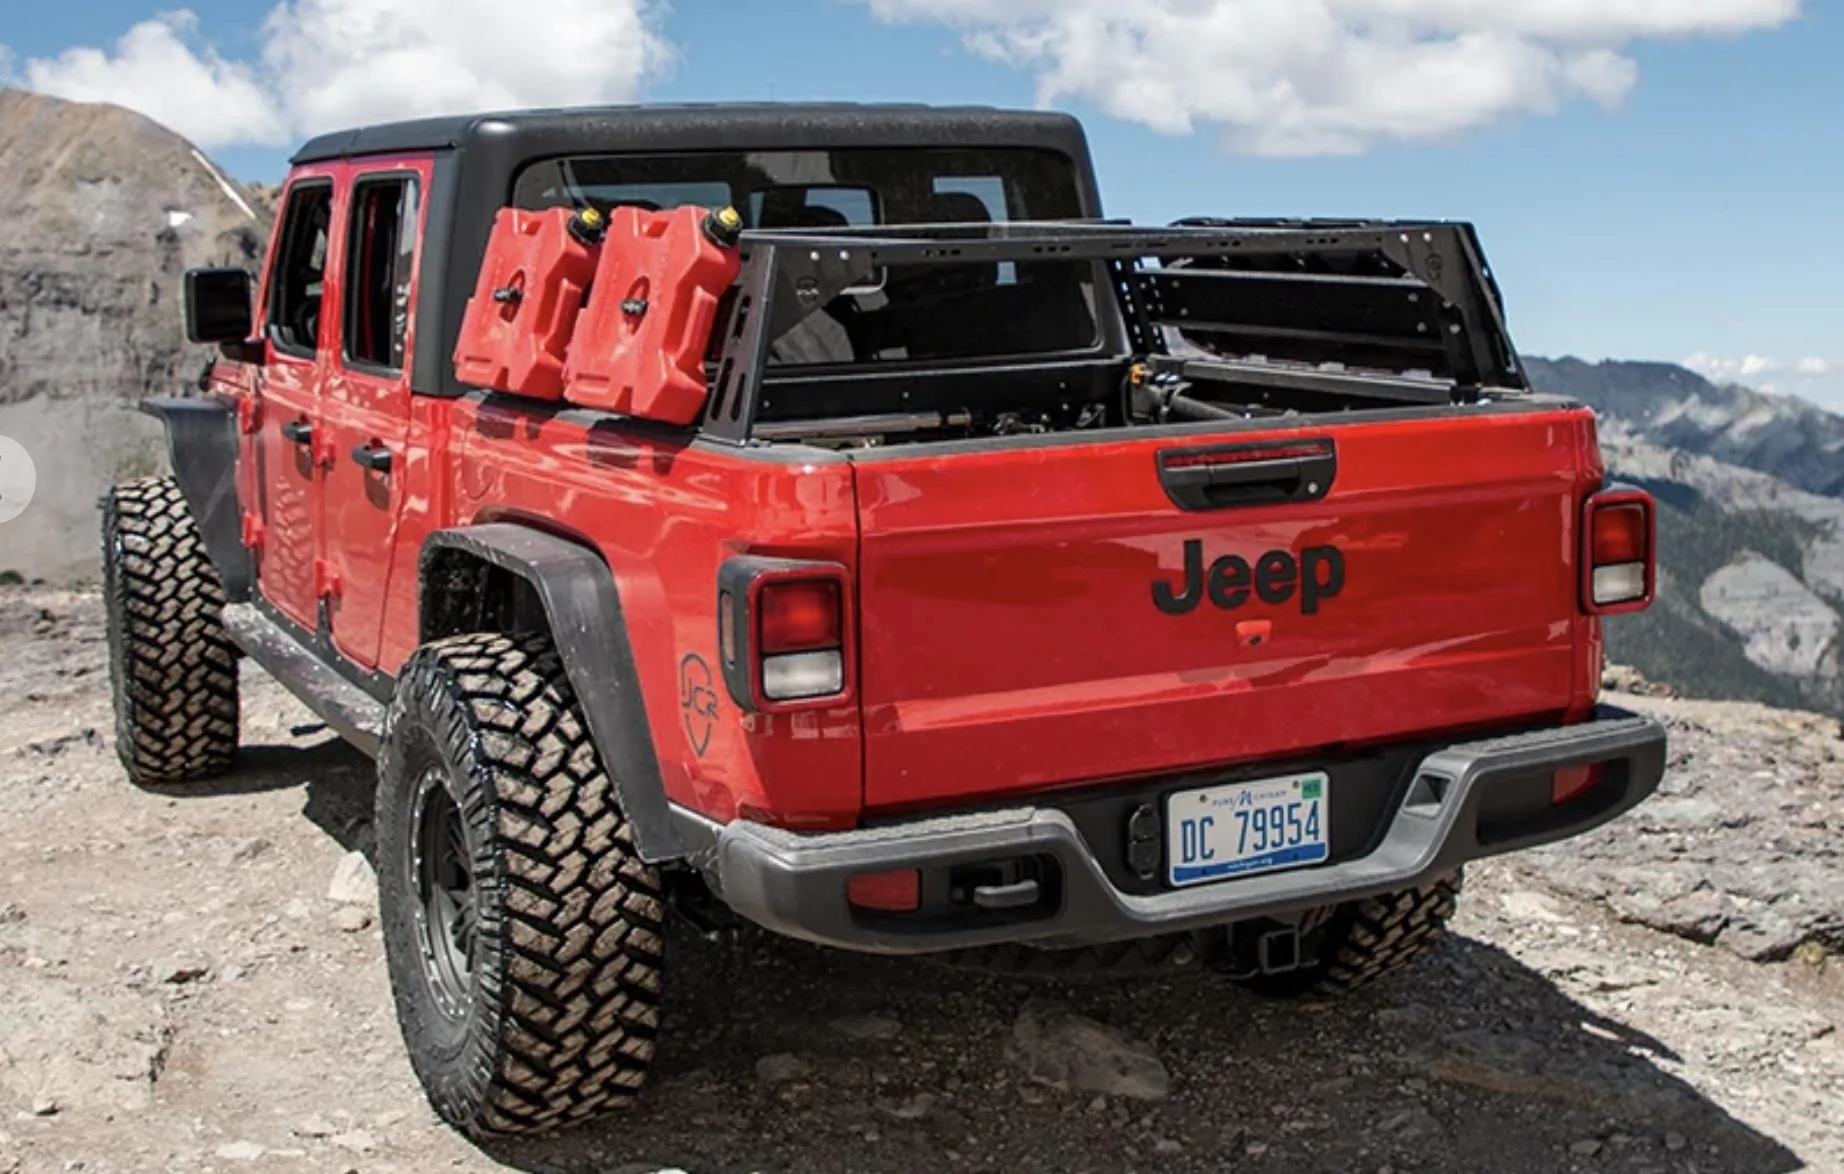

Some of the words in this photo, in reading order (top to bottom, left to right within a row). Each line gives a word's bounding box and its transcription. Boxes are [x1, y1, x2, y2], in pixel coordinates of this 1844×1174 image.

[1152, 538, 1344, 616] Jeep
[1181, 816, 1214, 863] DC
[1235, 801, 1319, 855] 79954
